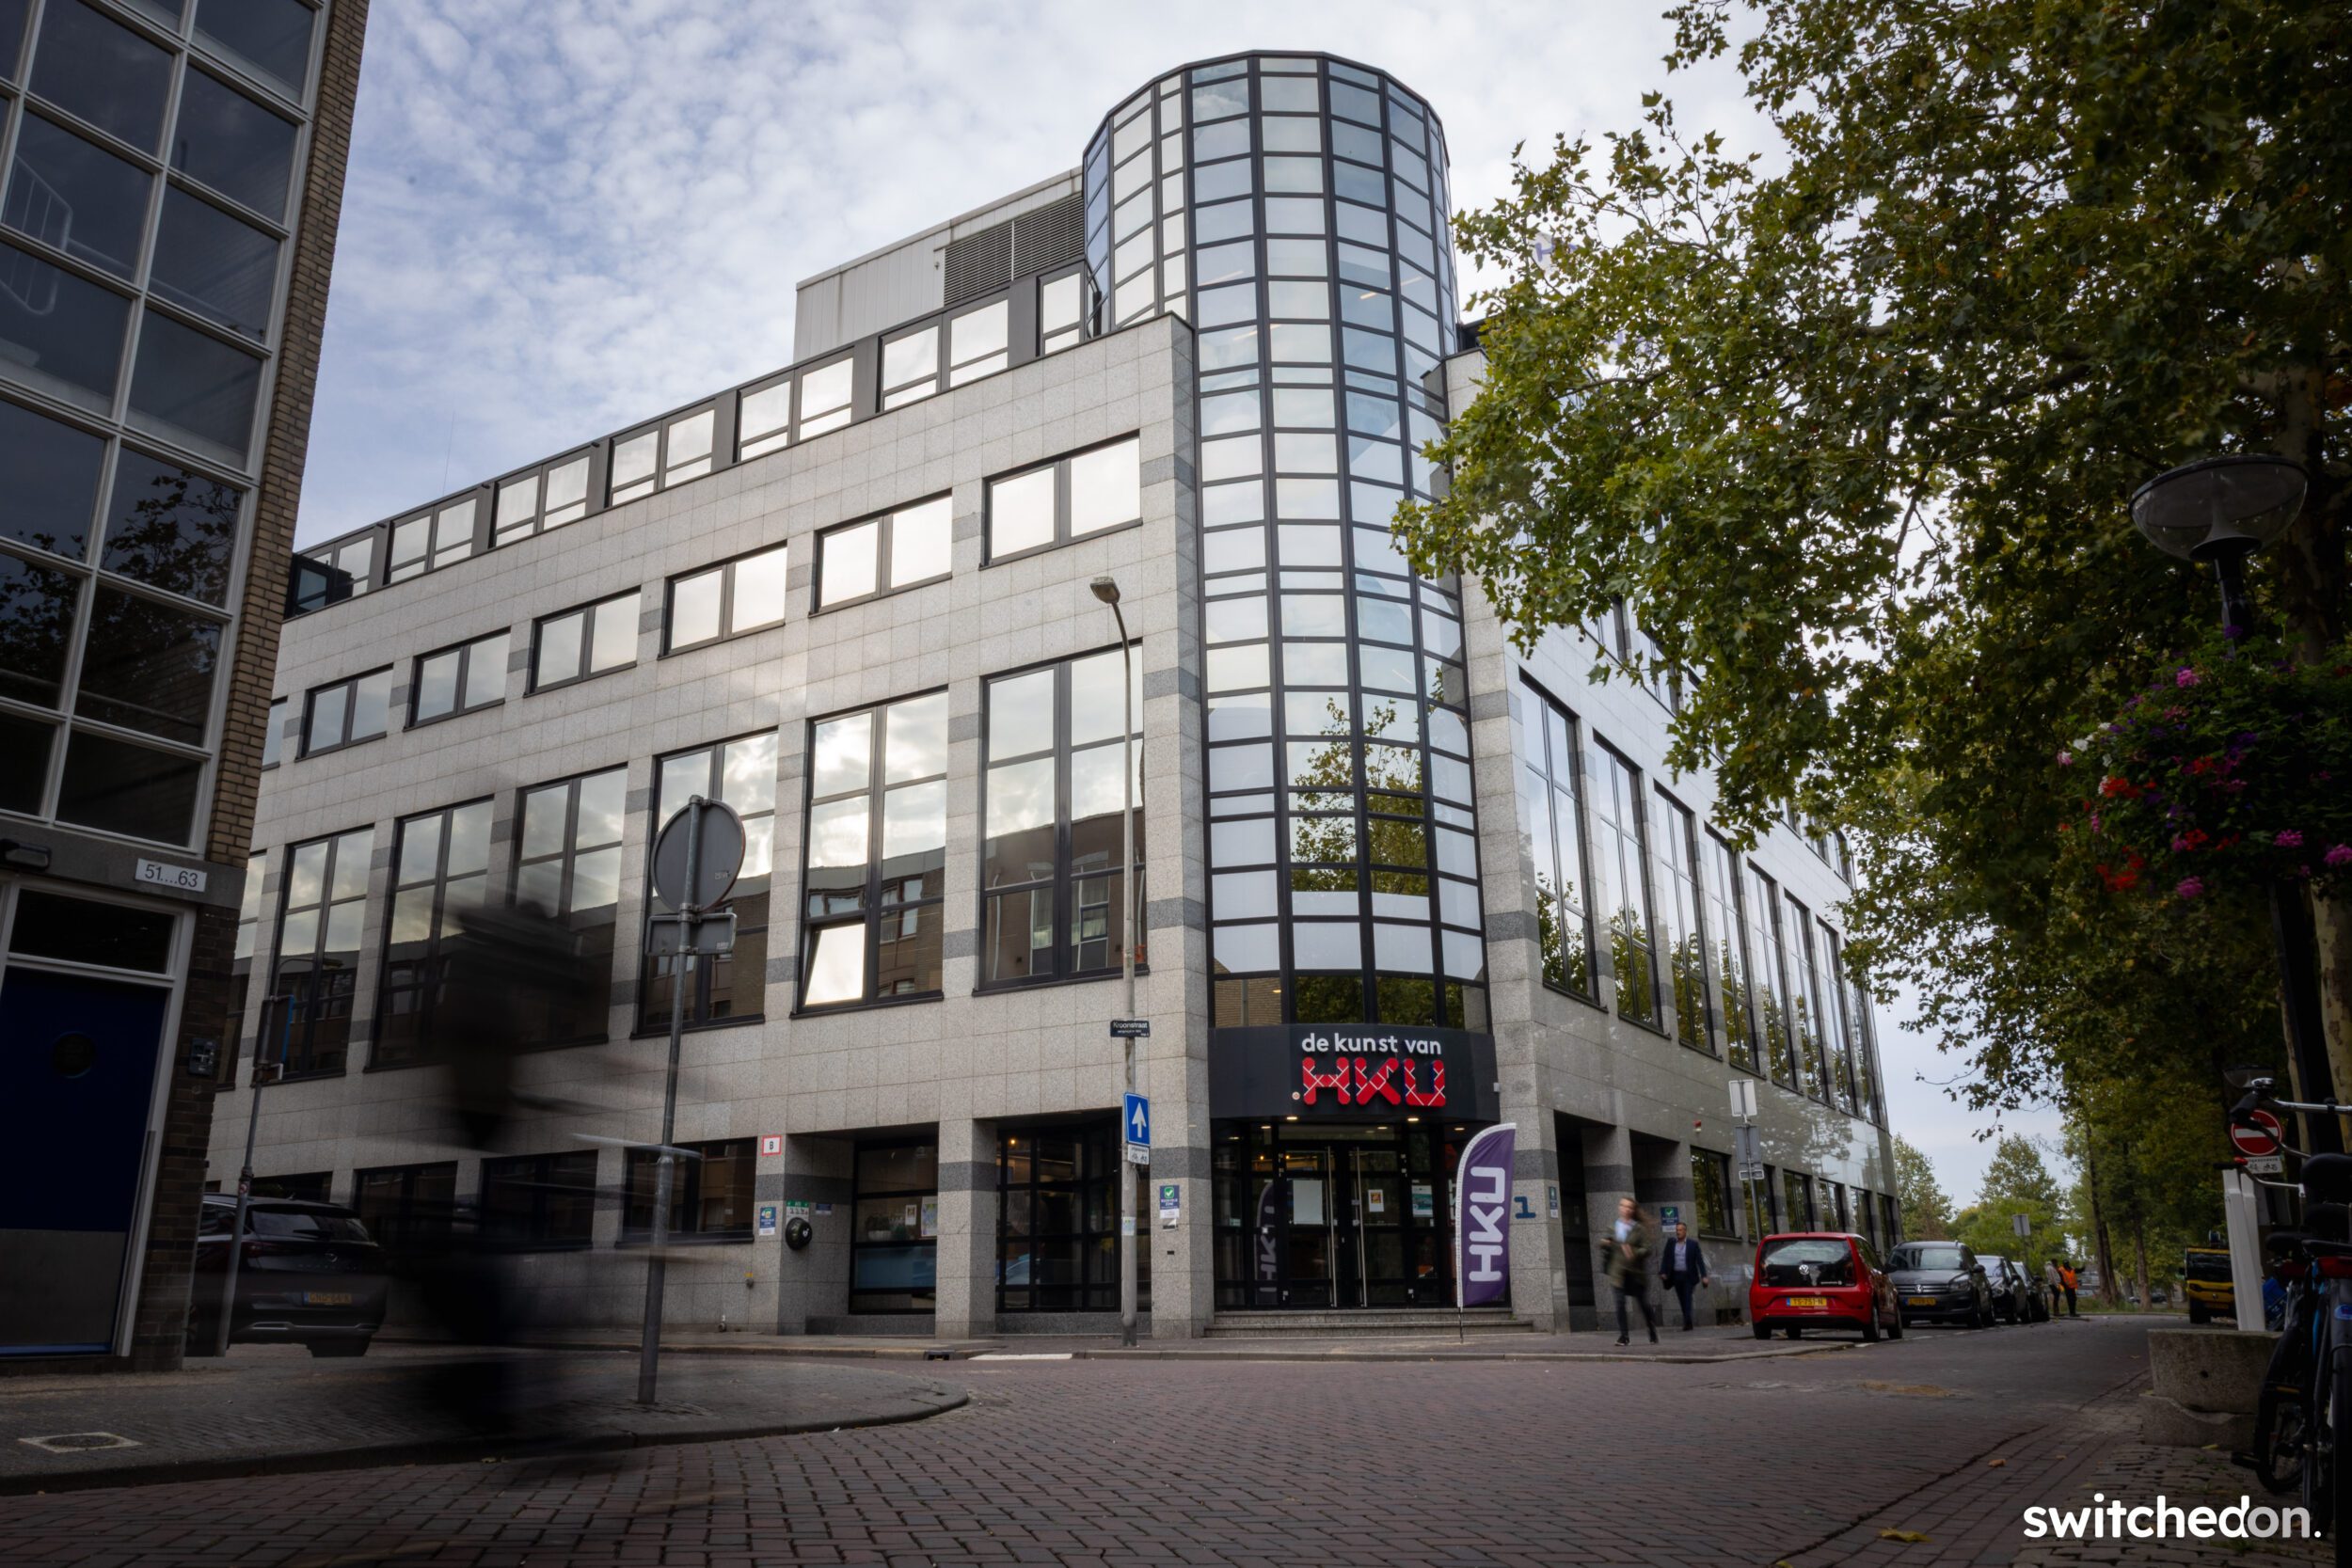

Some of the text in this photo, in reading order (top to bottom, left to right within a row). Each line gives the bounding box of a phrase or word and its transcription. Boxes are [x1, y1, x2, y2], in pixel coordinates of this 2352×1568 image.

[1302, 1033, 1442, 1055] de kunst van
[1302, 1056, 1446, 1107] HKU
[769, 1141, 774, 1149] B
[1514, 1196, 1536, 1219] 1
[1469, 1166, 1506, 1282] HKU
